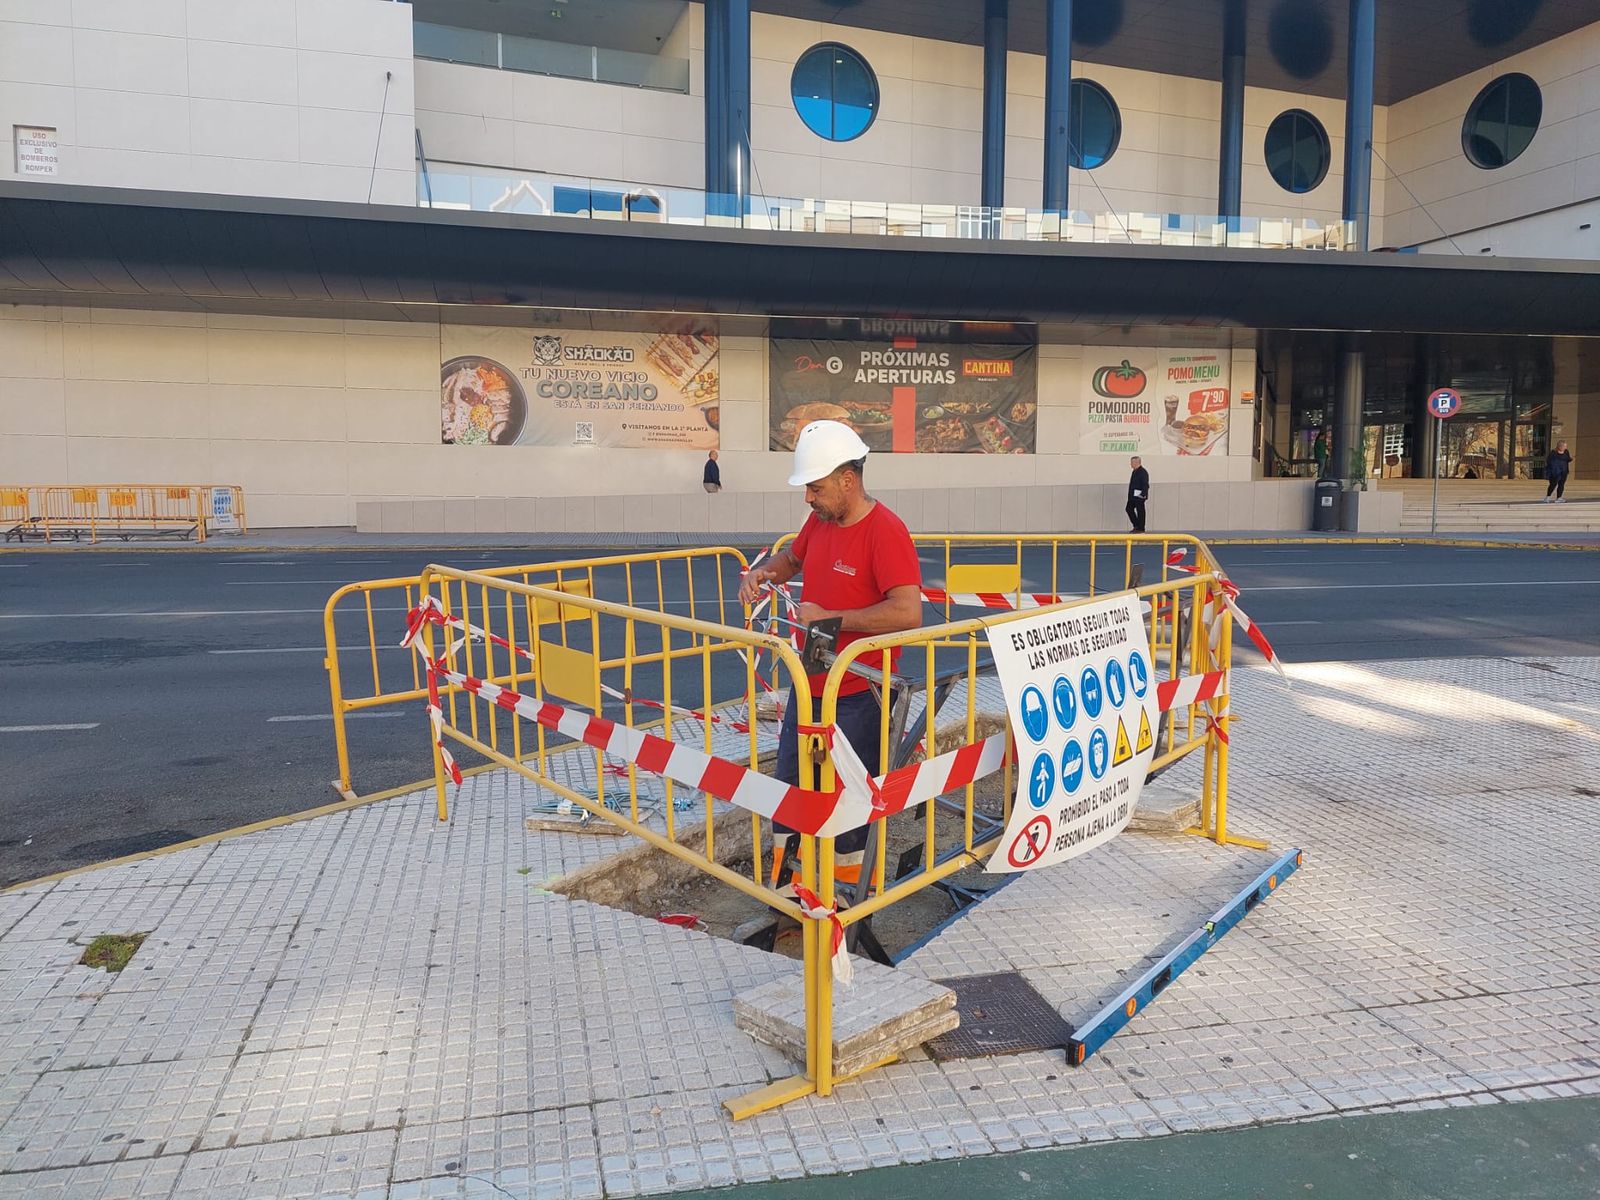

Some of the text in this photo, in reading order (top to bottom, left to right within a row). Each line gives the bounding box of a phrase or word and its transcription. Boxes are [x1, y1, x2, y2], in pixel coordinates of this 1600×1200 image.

[20, 139, 57, 148] EXCLUSIVO
[20, 154, 58, 163] BOMBEROS
[25, 164, 53, 173] ROMPER
[860, 348, 950, 367] PRÓXIMAS
[964, 361, 1010, 374] CANTINA
[520, 367, 648, 384] TU NUEVO VICIO
[854, 368, 956, 384] APERTURAS
[536, 380, 658, 401] COREANO
[553, 398, 685, 412] ESTÁ EN SAN FERNANDO
[1088, 401, 1151, 414] POMODORO
[1088, 414, 1150, 423] PIZZA PASTA BURRITOS
[1110, 443, 1136, 451] PLANTA
[1011, 606, 1130, 651] ES OBLIGATORIO SEGUIR TODAS
[1027, 627, 1128, 670] LAS NORMAS DE SEGURIDAD
[1059, 776, 1129, 827] PROHIBIDO EL PASO A TODA
[1053, 801, 1129, 853] PERSONA AJENA A LA OBRA
